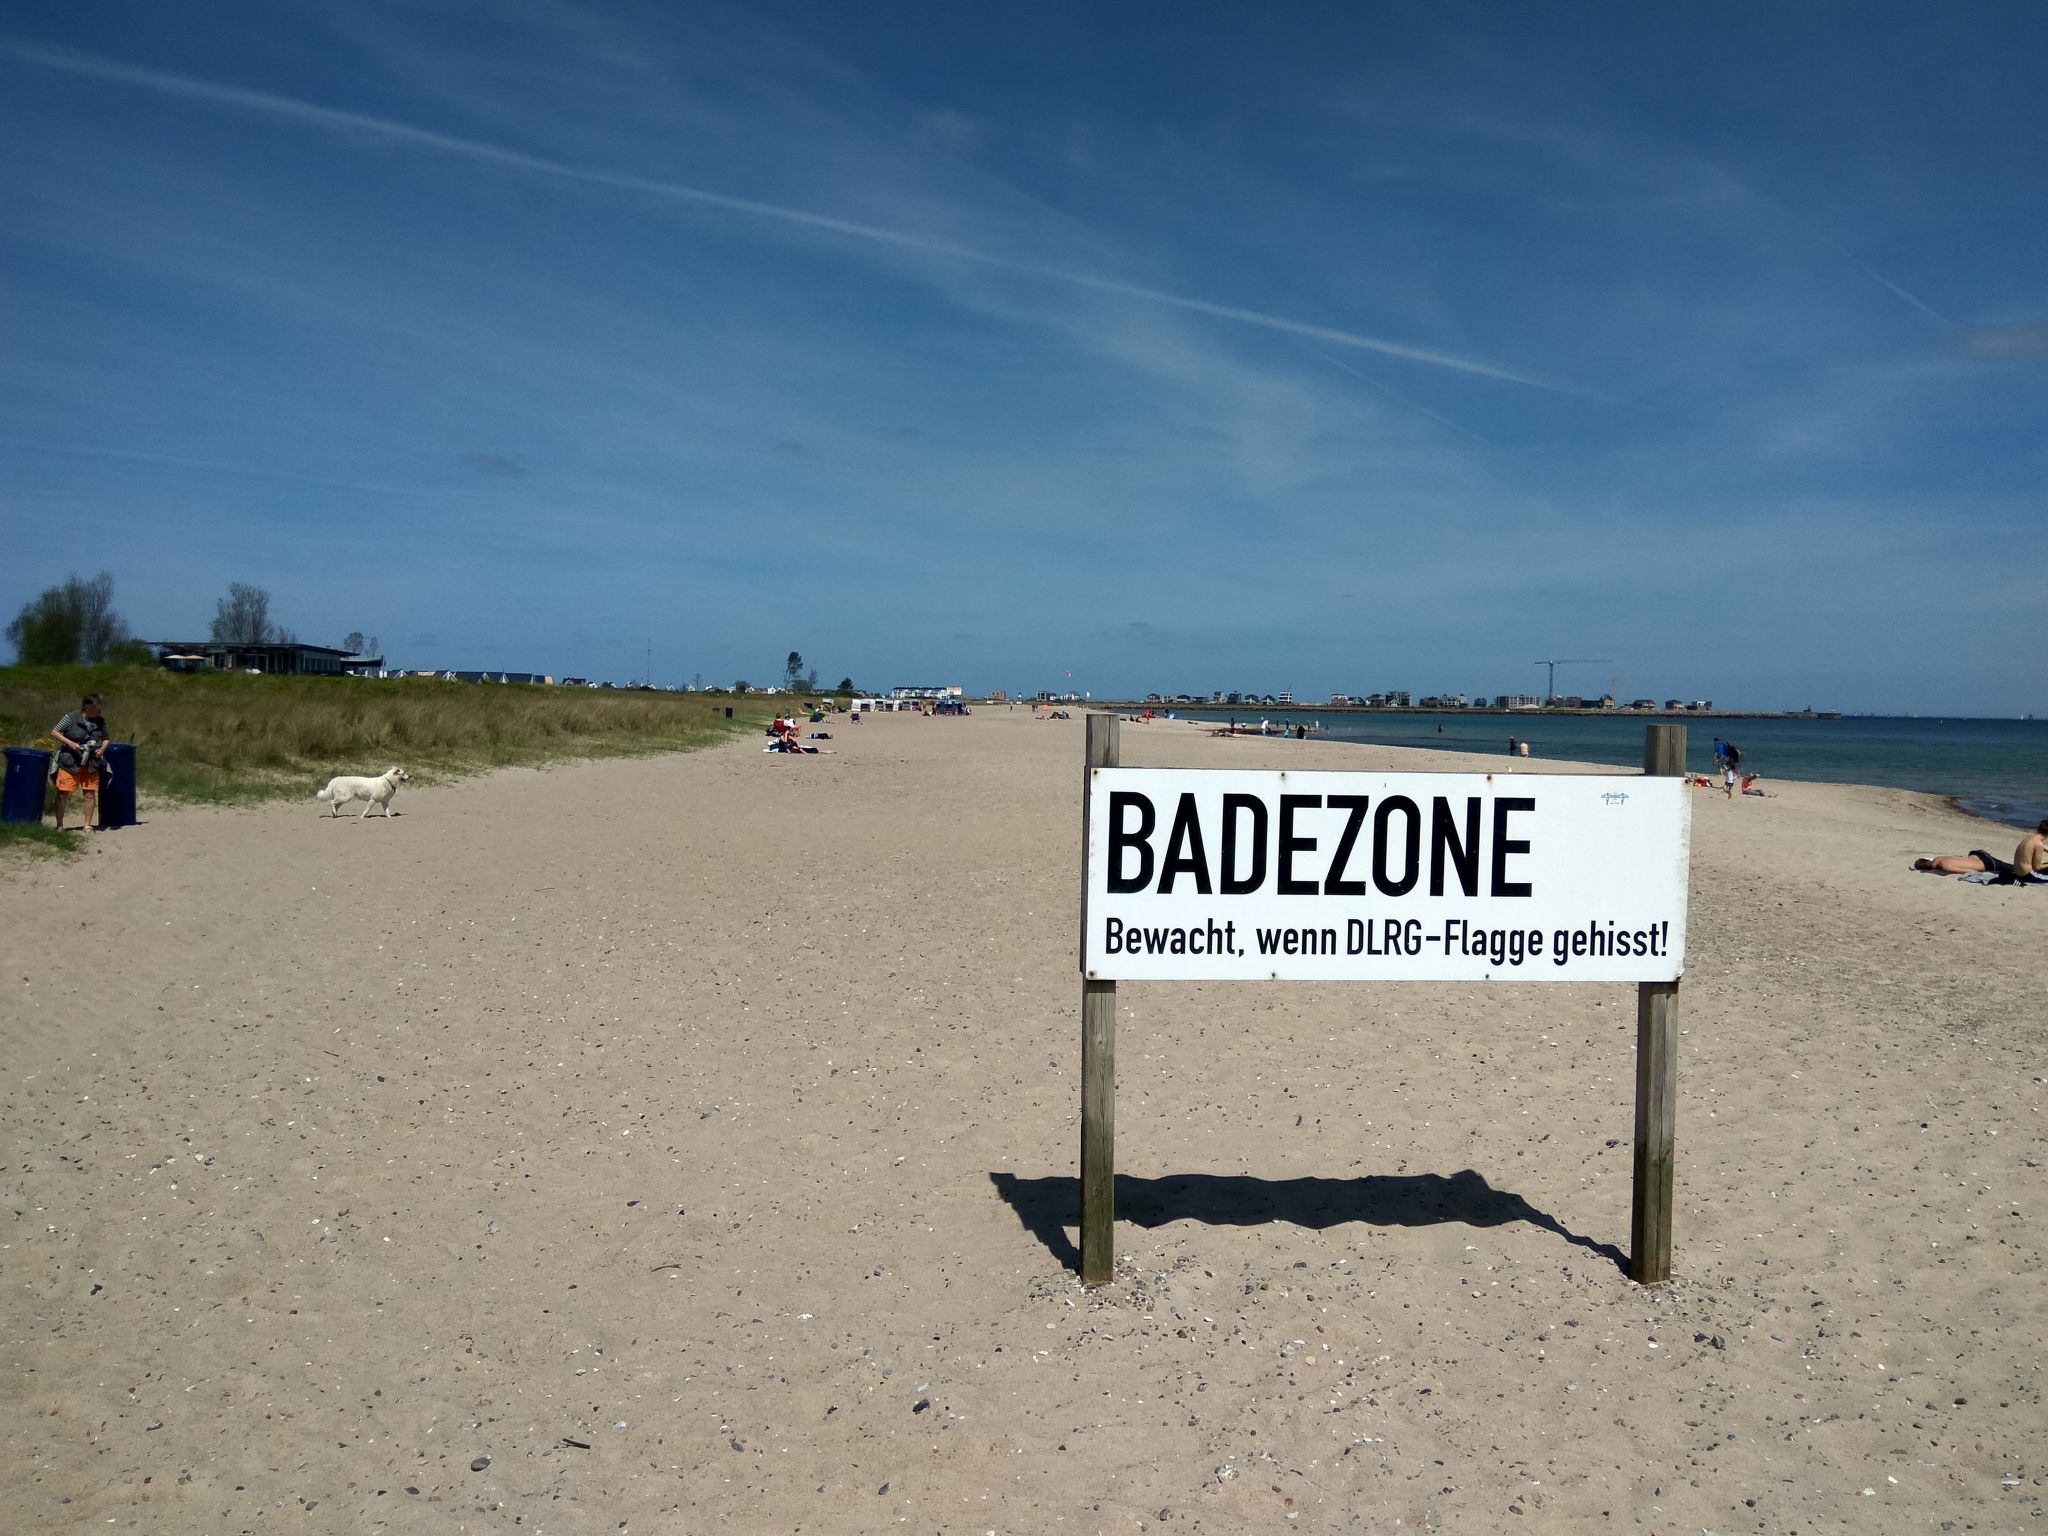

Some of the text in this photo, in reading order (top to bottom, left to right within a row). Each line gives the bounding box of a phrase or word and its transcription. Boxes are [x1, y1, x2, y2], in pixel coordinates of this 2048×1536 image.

[1106, 790, 1536, 898] BADEZONE
[1105, 917, 1669, 967] Bewacht, wenn DLRG-Flagge gehisst!
